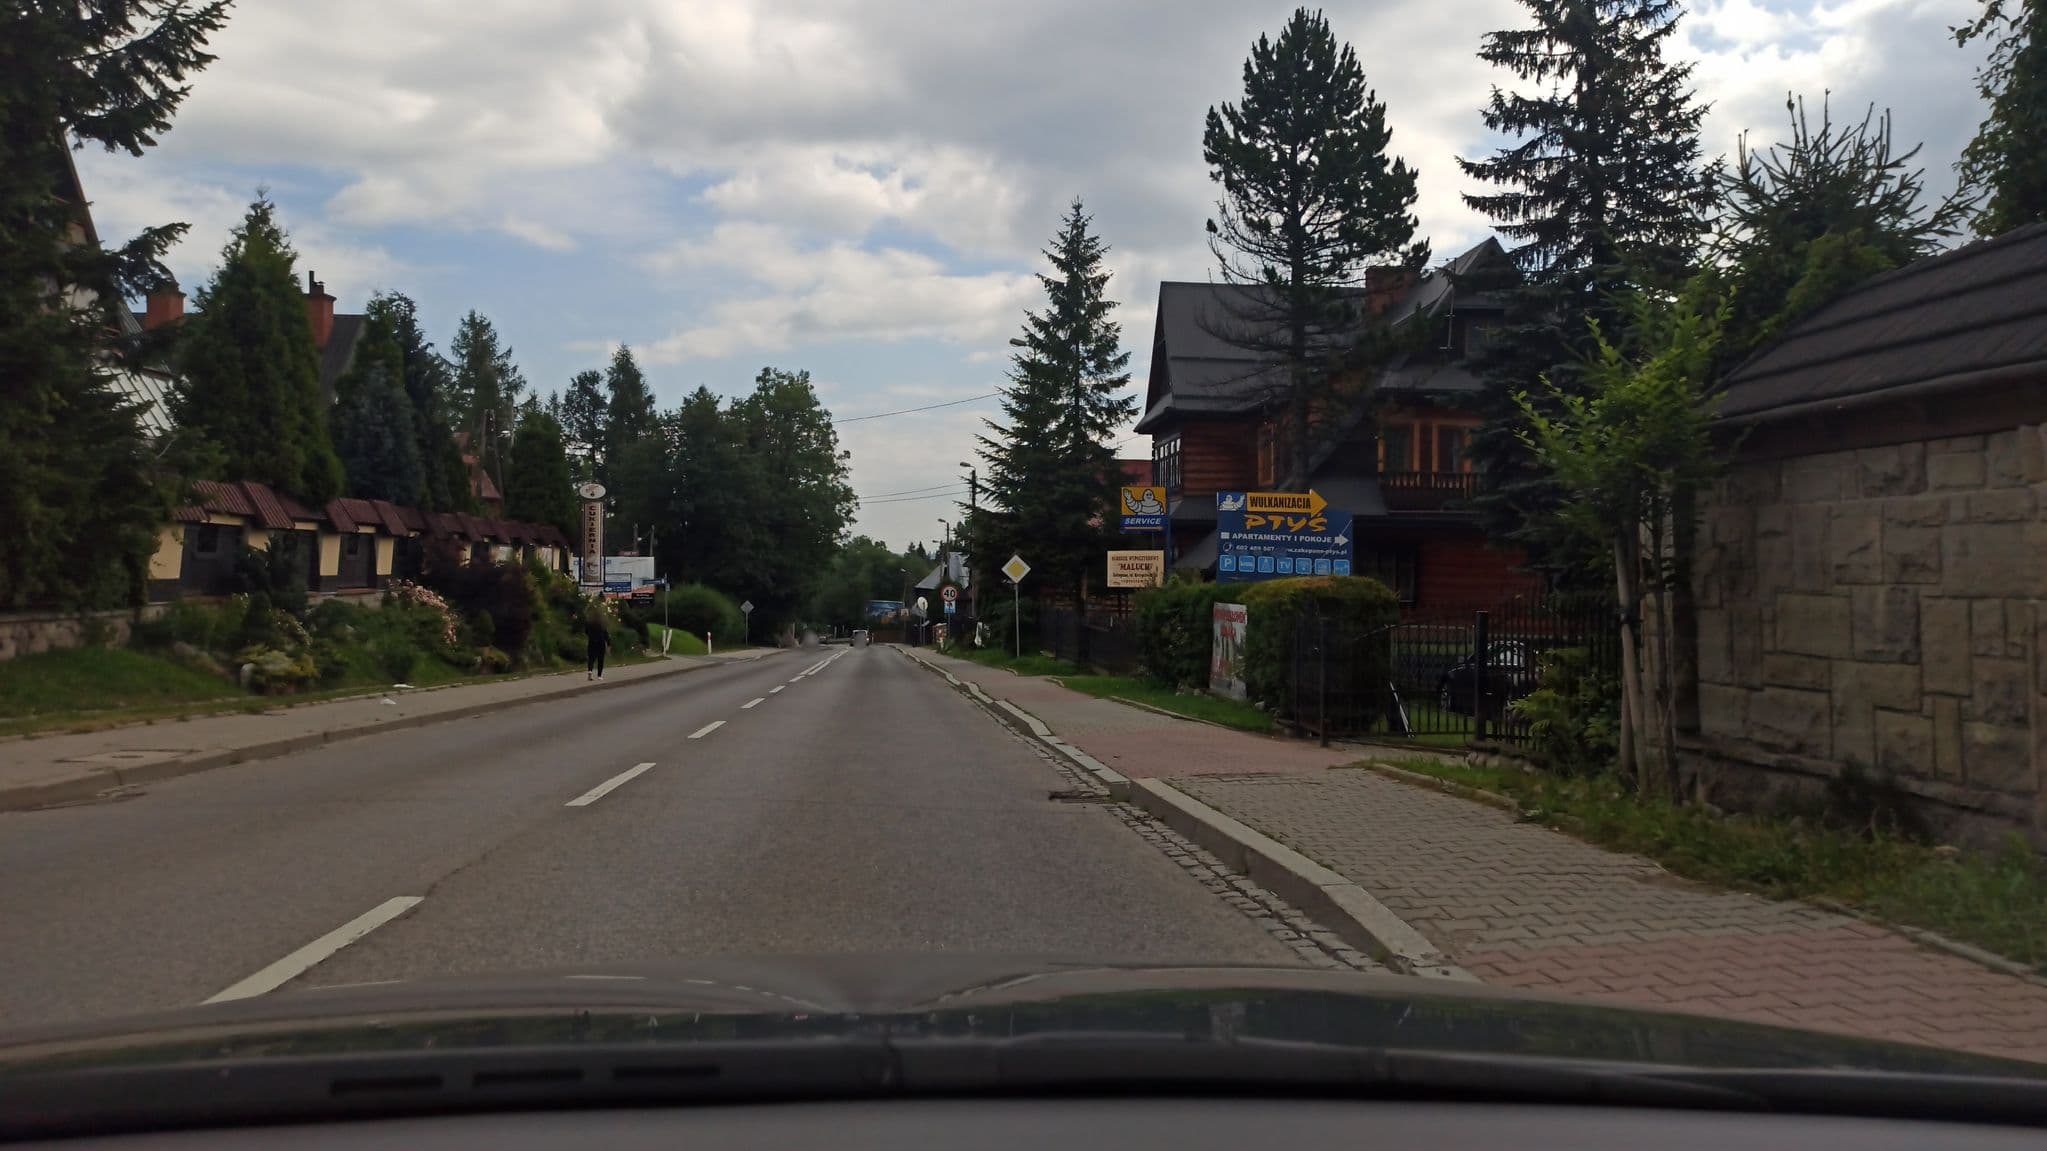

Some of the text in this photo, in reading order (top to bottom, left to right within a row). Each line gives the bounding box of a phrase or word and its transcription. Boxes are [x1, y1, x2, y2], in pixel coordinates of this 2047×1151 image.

[1250, 496, 1311, 509] WULKANIZACJA
[1244, 513, 1328, 532] PTYŚ
[1232, 533, 1292, 542] APARTAMENTY
[1224, 559, 1231, 567] P
[944, 589, 955, 598] 40
